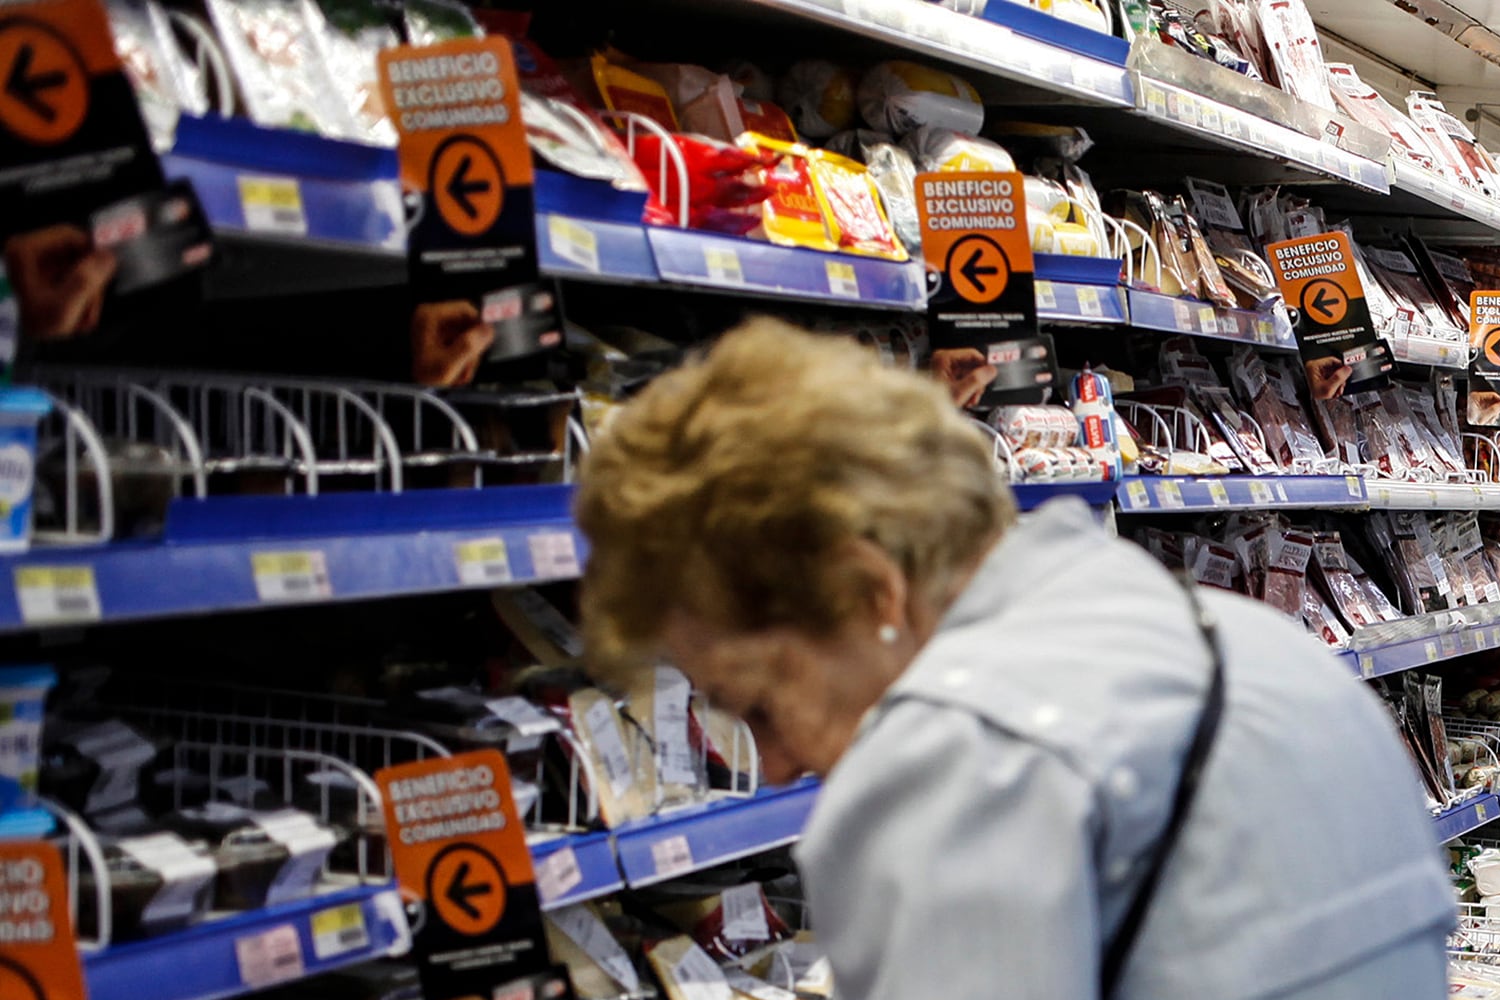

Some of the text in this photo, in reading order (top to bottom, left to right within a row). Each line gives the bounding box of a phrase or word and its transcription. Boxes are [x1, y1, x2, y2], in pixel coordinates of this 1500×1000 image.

[387, 52, 497, 82] BENEFICIO
[393, 78, 504, 108] EXCLUSIVO
[400, 104, 510, 131] COMUNIDAD
[923, 181, 1012, 198] BENEFICIO
[926, 200, 1013, 214] EXCLUSIVO
[928, 216, 1016, 230] COMUNIDAD
[1275, 239, 1339, 260] BENEFICIO
[1280, 251, 1343, 270] EXCLUSIVO
[1283, 262, 1346, 280] COMUNIDAD
[1088, 418, 1101, 447] SILVIA
[388, 765, 494, 801] BENEFICIO
[394, 789, 500, 824] EXCLUSIVO
[399, 810, 506, 845] COMUNIDAD
